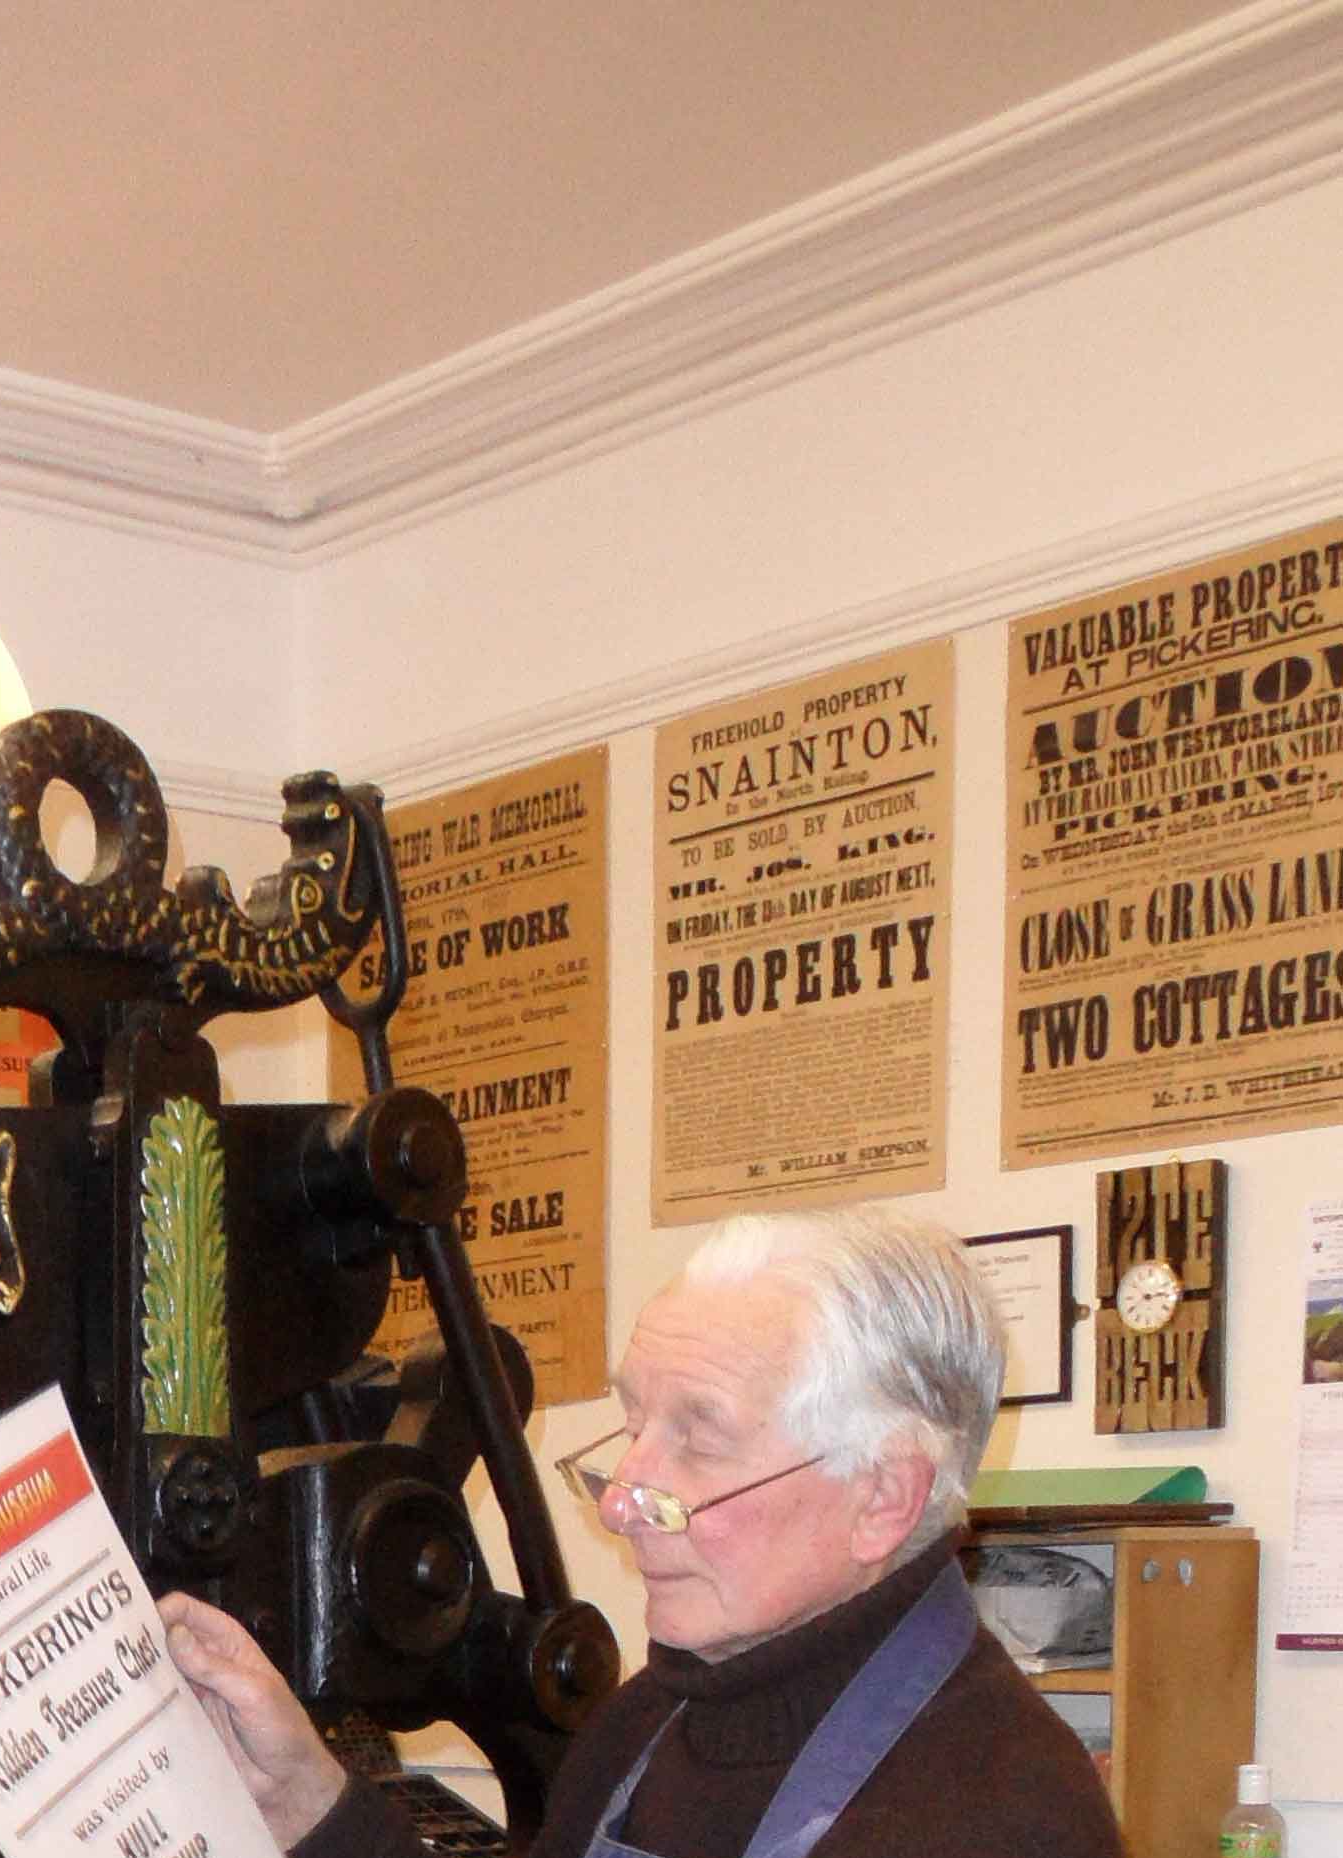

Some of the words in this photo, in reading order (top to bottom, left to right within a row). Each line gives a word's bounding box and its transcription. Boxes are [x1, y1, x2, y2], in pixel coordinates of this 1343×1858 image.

[1024, 592, 1175, 676] VALUABLE
[1062, 658, 1110, 696] AT
[1126, 600, 1325, 678] PICKERING.
[691, 710, 785, 755] FREEHOLD
[803, 674, 908, 723] PROPERTY
[667, 704, 938, 813] SNAINTON,
[1039, 766, 1063, 796] BY
[1109, 739, 1159, 777] JOHN
[1232, 742, 1283, 777] PARK
[441, 811, 481, 857] WAR
[681, 846, 702, 868] TO
[714, 837, 735, 858] BE
[747, 823, 789, 852] SOLD
[804, 814, 827, 837] BY
[436, 927, 472, 971] OF
[479, 901, 571, 959] WORK
[736, 901, 757, 929] THE
[789, 884, 818, 917] DAY
[820, 881, 837, 910] OF
[840, 869, 892, 905] AUGUST
[1019, 897, 1110, 974] CLOSE
[1145, 867, 1255, 946] GRASS
[665, 915, 935, 1032] PROPERTY
[1017, 993, 1110, 1074] TWO
[778, 1151, 848, 1173] WILLIAM
[490, 1191, 564, 1237] SALE
[19, 1546, 54, 1583] Life
[38, 1665, 123, 1742] Treasure
[113, 1623, 163, 1681] Chest
[73, 1808, 105, 1843] was
[103, 1758, 151, 1816] visited
[148, 1746, 171, 1771] by
